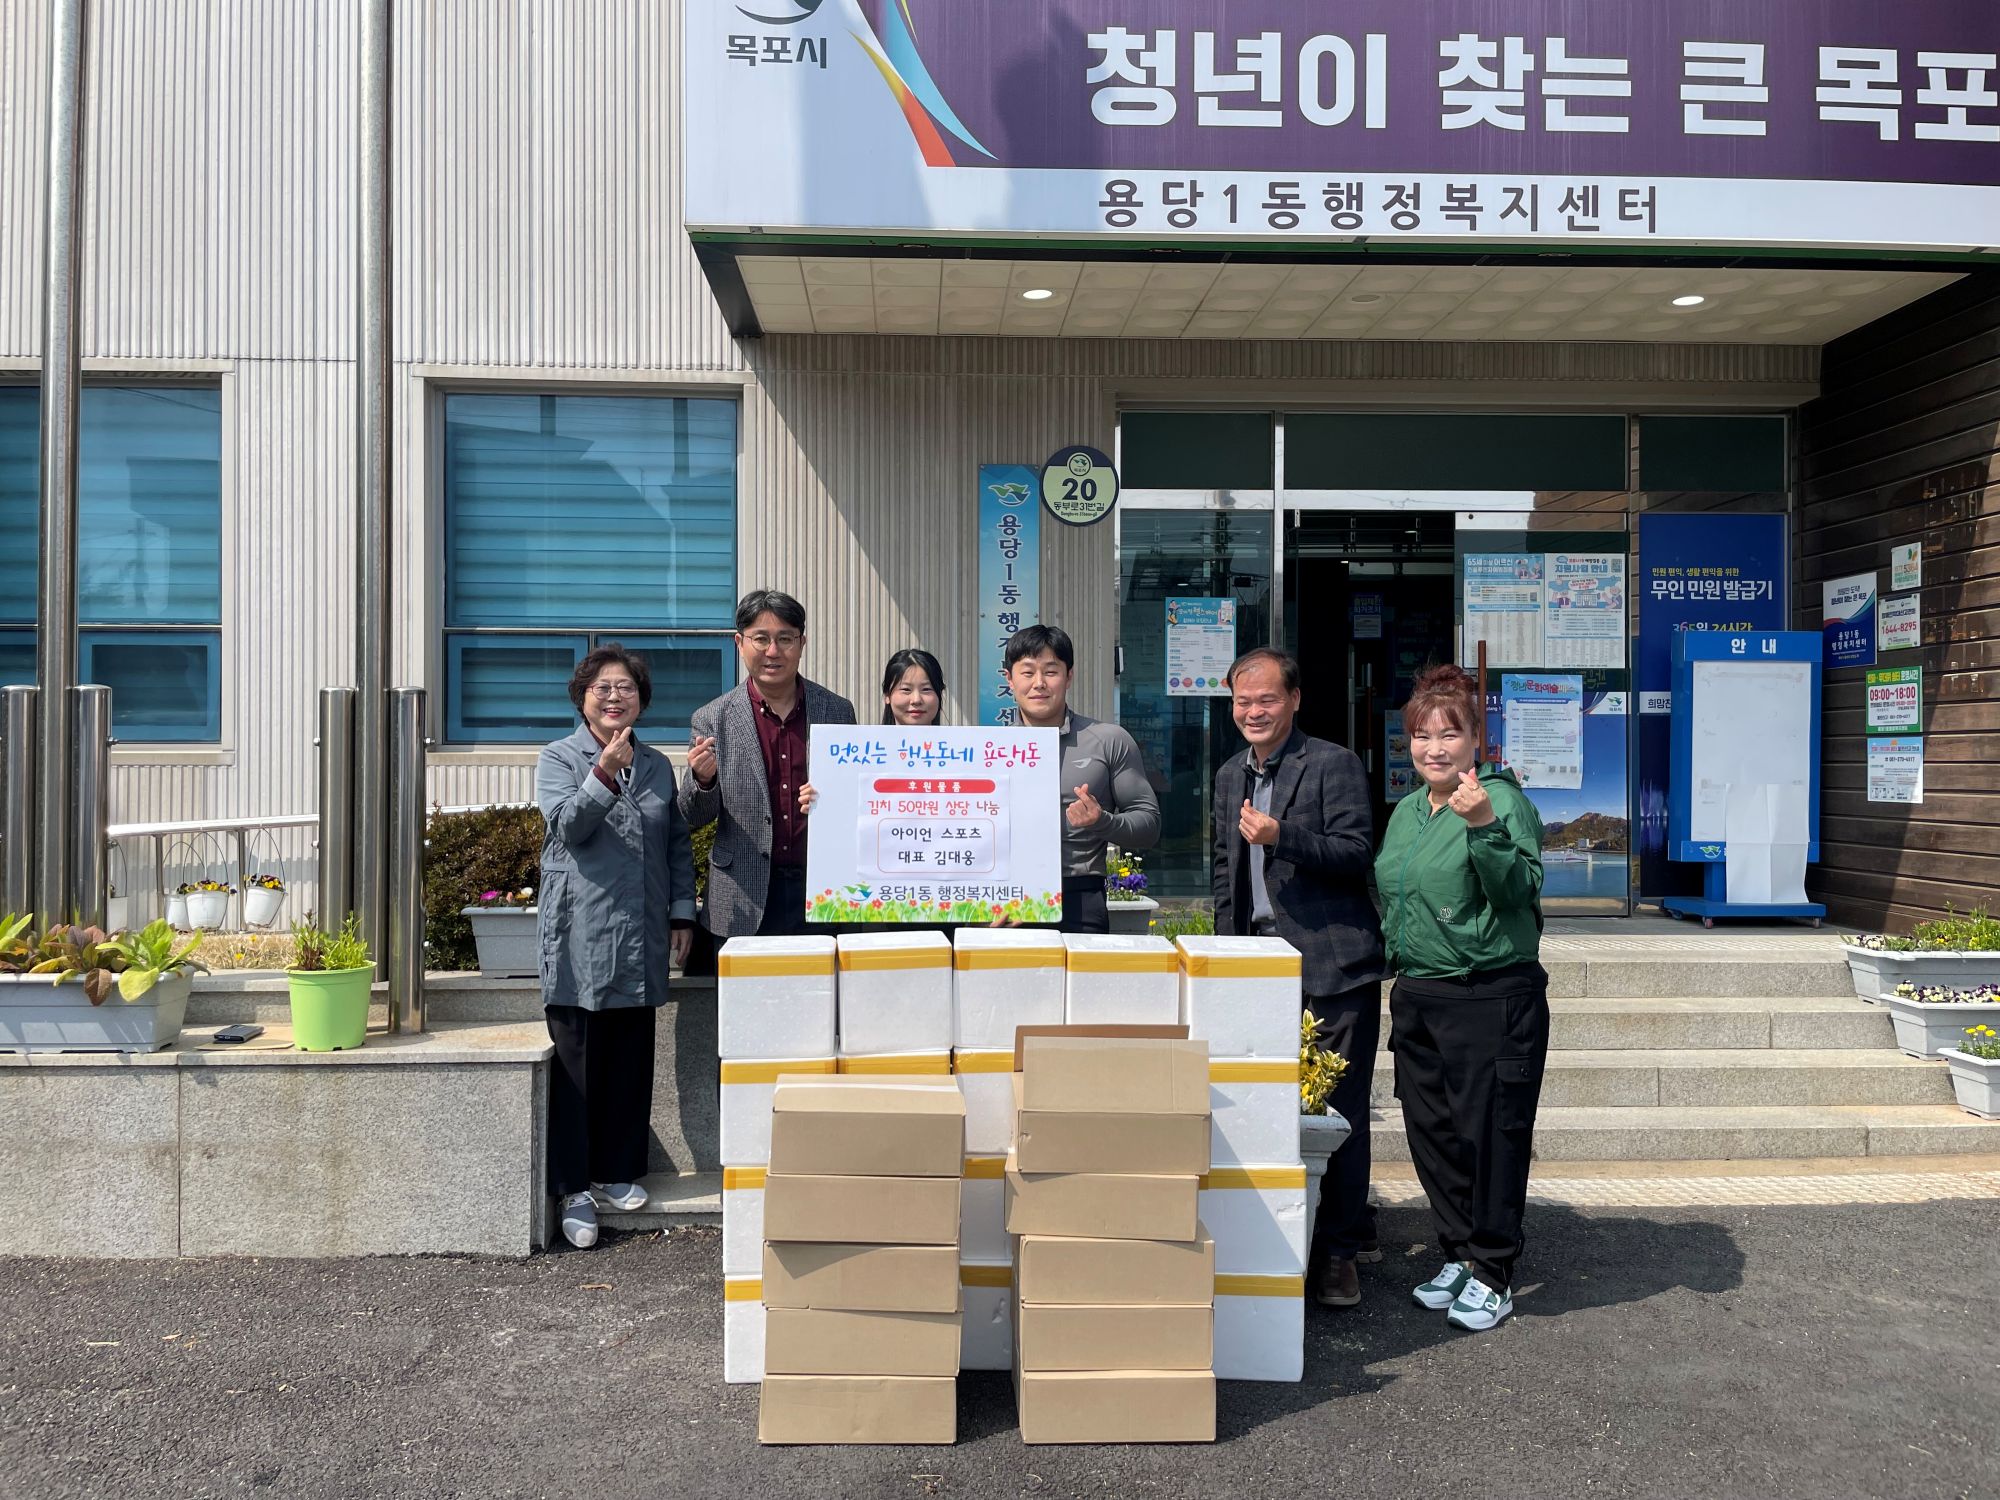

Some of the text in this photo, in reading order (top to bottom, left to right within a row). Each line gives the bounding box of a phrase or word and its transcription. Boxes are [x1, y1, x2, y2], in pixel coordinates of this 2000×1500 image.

[726, 34, 828, 69] 목포시
[1086, 26, 2000, 142] 청년이 찾는 큰 목포
[1062, 478, 1097, 501] 20
[1053, 501, 1105, 512] 동부로31번길
[1652, 568, 1739, 577] 민원 편익, 생활 편익을 위한
[1651, 580, 1773, 600] 무인 민원 발급기
[1881, 621, 1917, 635] 1644-8295
[1869, 686, 1916, 701] 09:00~18:00
[830, 739, 1041, 768] 멋있는 행복동네 용당1동
[908, 781, 961, 792] 후원물품
[867, 800, 1000, 816] 김치 50만원 상당 나눔
[891, 827, 982, 842] 아이언 스포츠
[898, 850, 976, 866] 대표 김대웅
[879, 885, 1024, 901] 용당1동 행정복지센터
